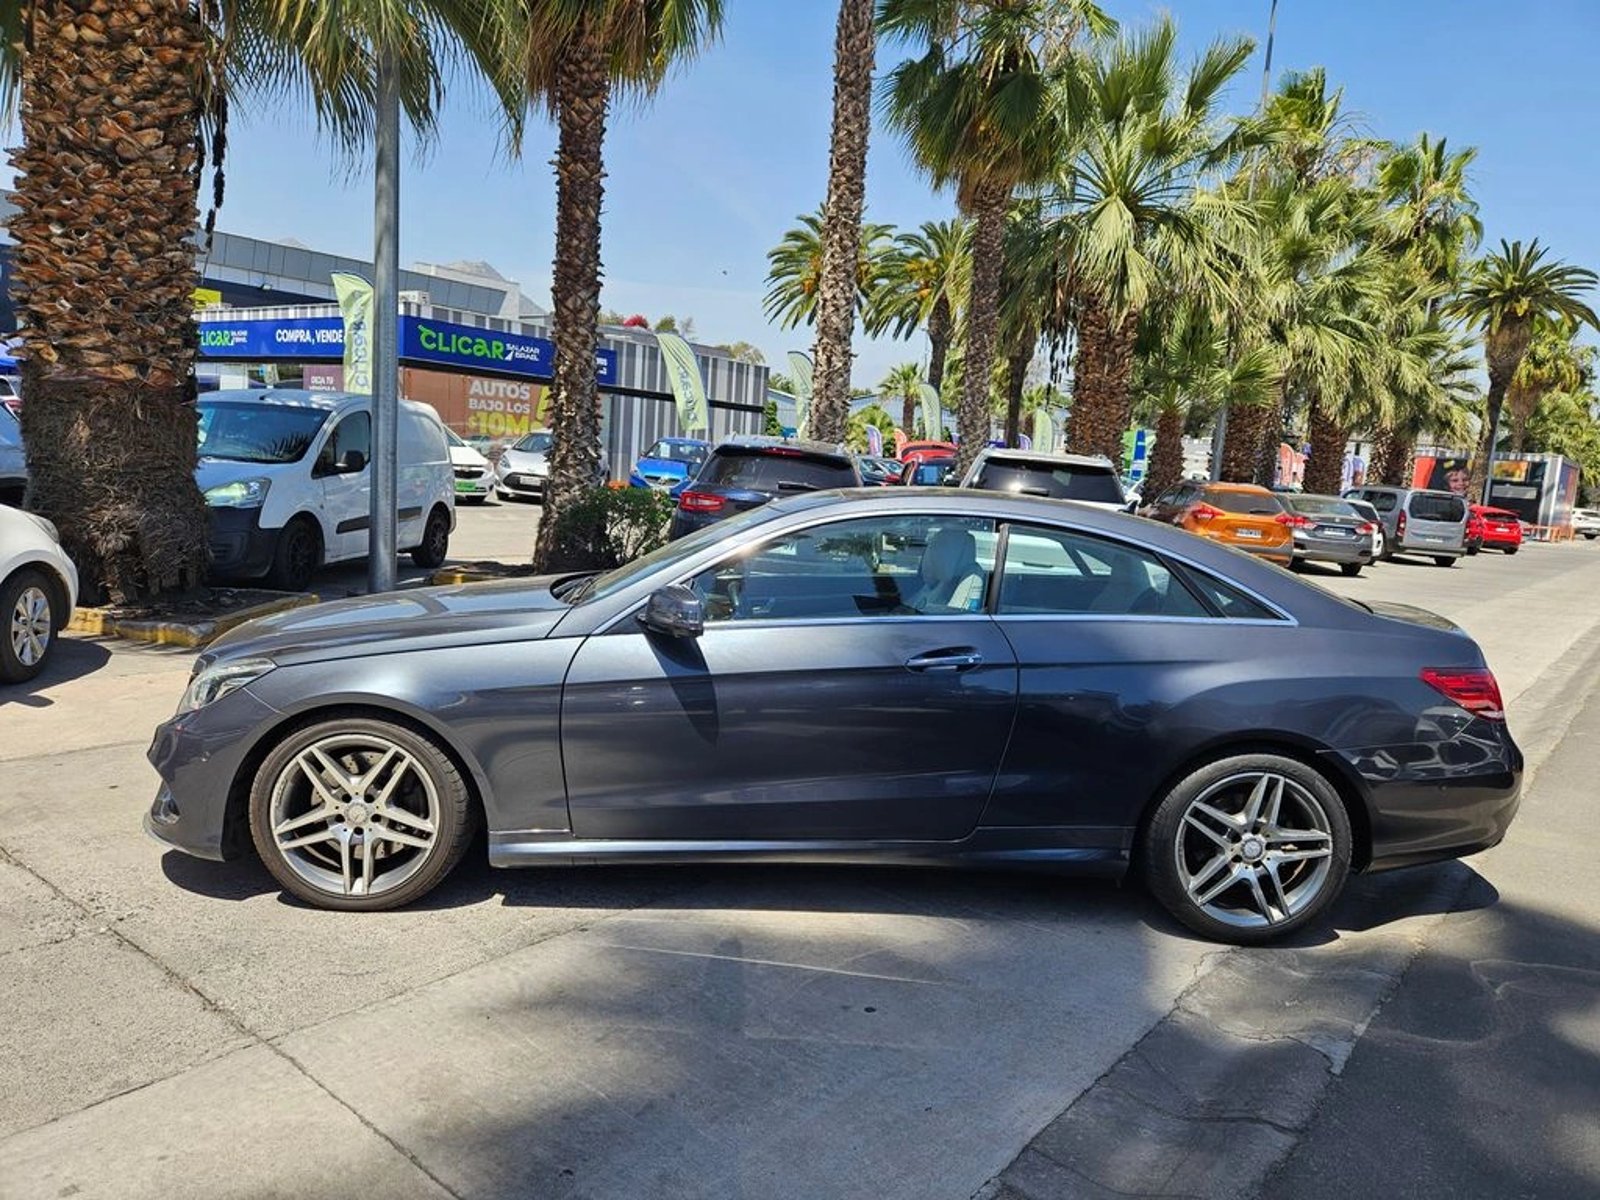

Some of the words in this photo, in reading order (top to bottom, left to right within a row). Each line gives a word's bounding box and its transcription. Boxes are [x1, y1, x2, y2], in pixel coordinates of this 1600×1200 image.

[276, 329, 315, 345] COMPRA,
[315, 329, 343, 343] VENDE
[469, 381, 531, 400] AUTOS
[468, 399, 504, 412] BAJO
[506, 401, 531, 415] LOS
